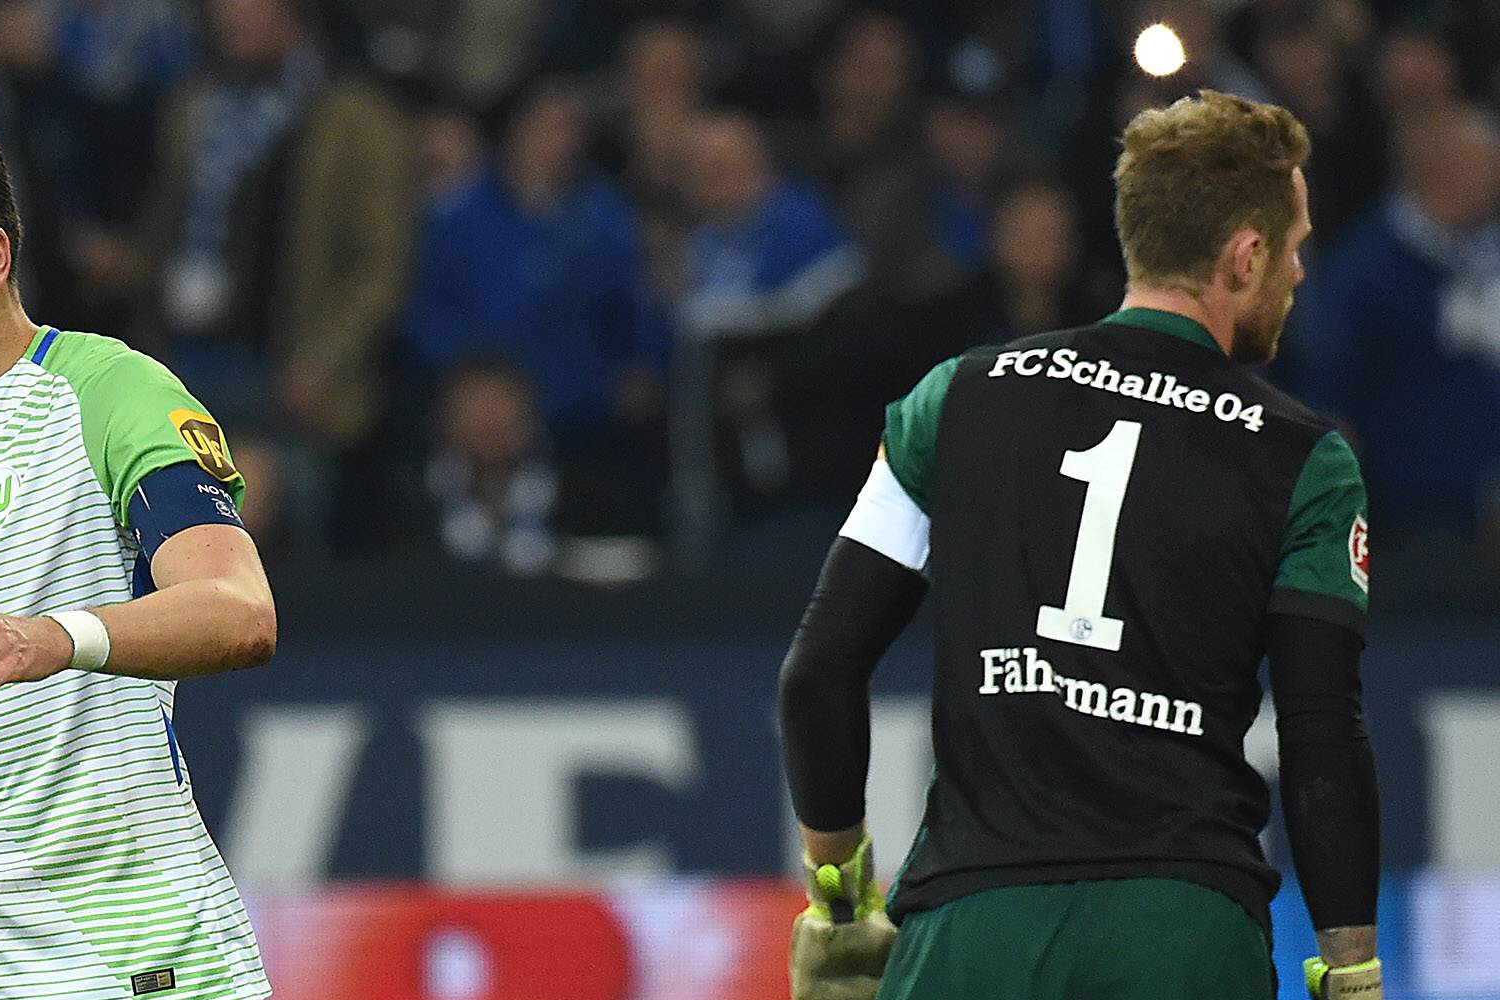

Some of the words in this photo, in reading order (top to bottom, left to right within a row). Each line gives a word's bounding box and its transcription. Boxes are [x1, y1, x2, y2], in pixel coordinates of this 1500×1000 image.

[989, 349, 1047, 378] FC
[1046, 348, 1210, 413] Schalke
[1213, 391, 1264, 432] 04
[197, 483, 219, 496] NO
[1036, 419, 1142, 652] 1
